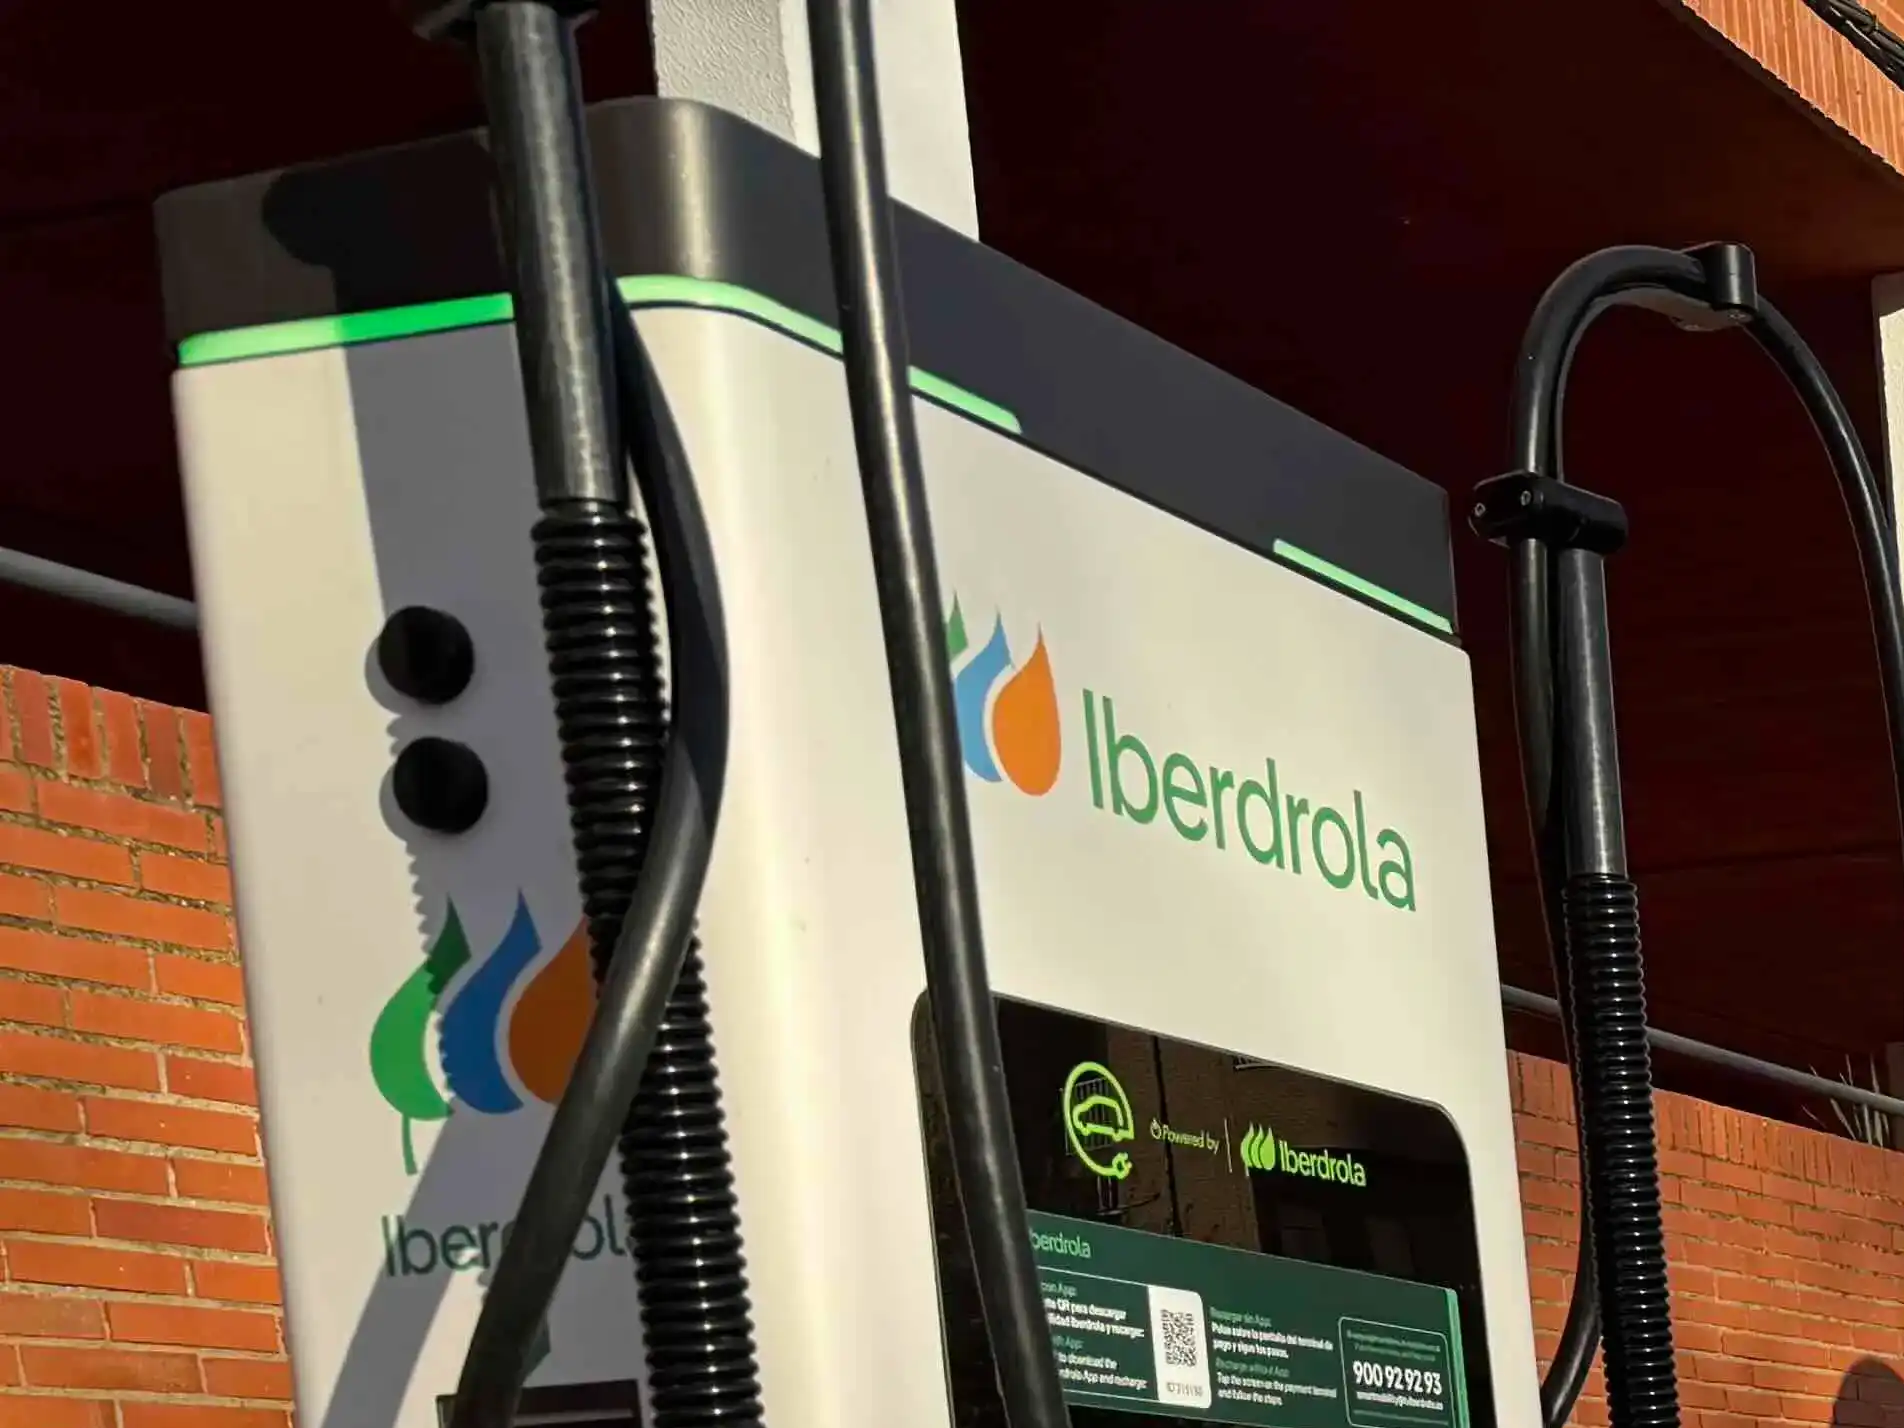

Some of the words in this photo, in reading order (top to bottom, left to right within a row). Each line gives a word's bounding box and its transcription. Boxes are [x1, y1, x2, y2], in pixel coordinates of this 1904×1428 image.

[1083, 688, 1416, 912] Iberdrola
[1162, 1124, 1204, 1148] Powered
[1206, 1130, 1219, 1154] by
[1279, 1140, 1366, 1187] Iberdrola
[1029, 1228, 1092, 1258] berdrola
[1353, 1360, 1383, 1387] 900
[1384, 1365, 1404, 1391] 92
[1405, 1368, 1424, 1393] 92
[1424, 1371, 1442, 1396] 93
